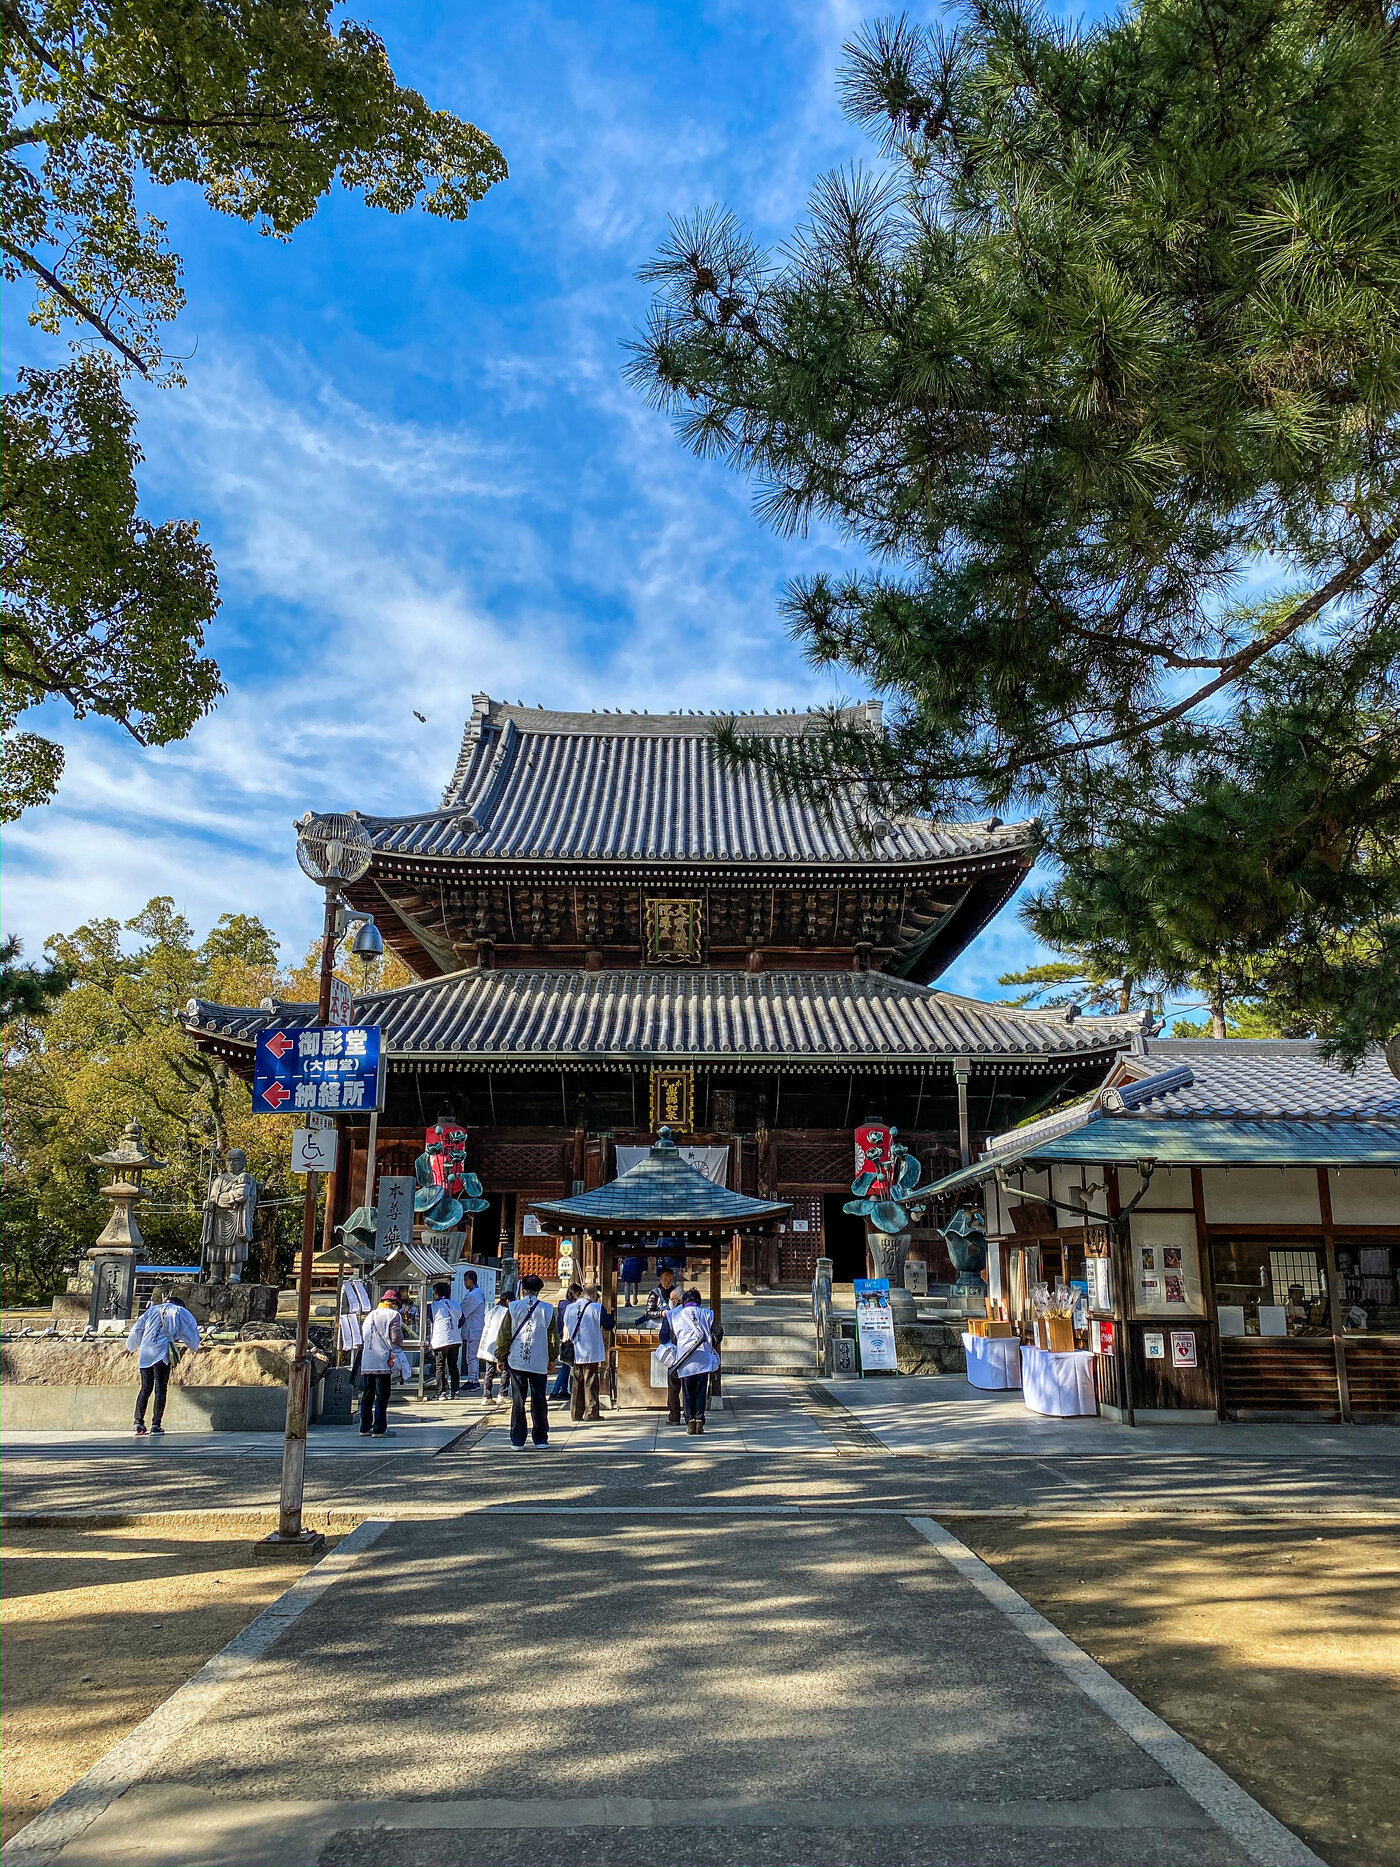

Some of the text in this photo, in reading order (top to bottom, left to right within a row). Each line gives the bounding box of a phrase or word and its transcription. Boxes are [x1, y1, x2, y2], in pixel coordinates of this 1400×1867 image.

[298, 1029, 368, 1057] 御影堂
[303, 1058, 360, 1073] (大師堂)
[294, 1080, 365, 1108] 納経所
[333, 1374, 344, 1407] お杖立
